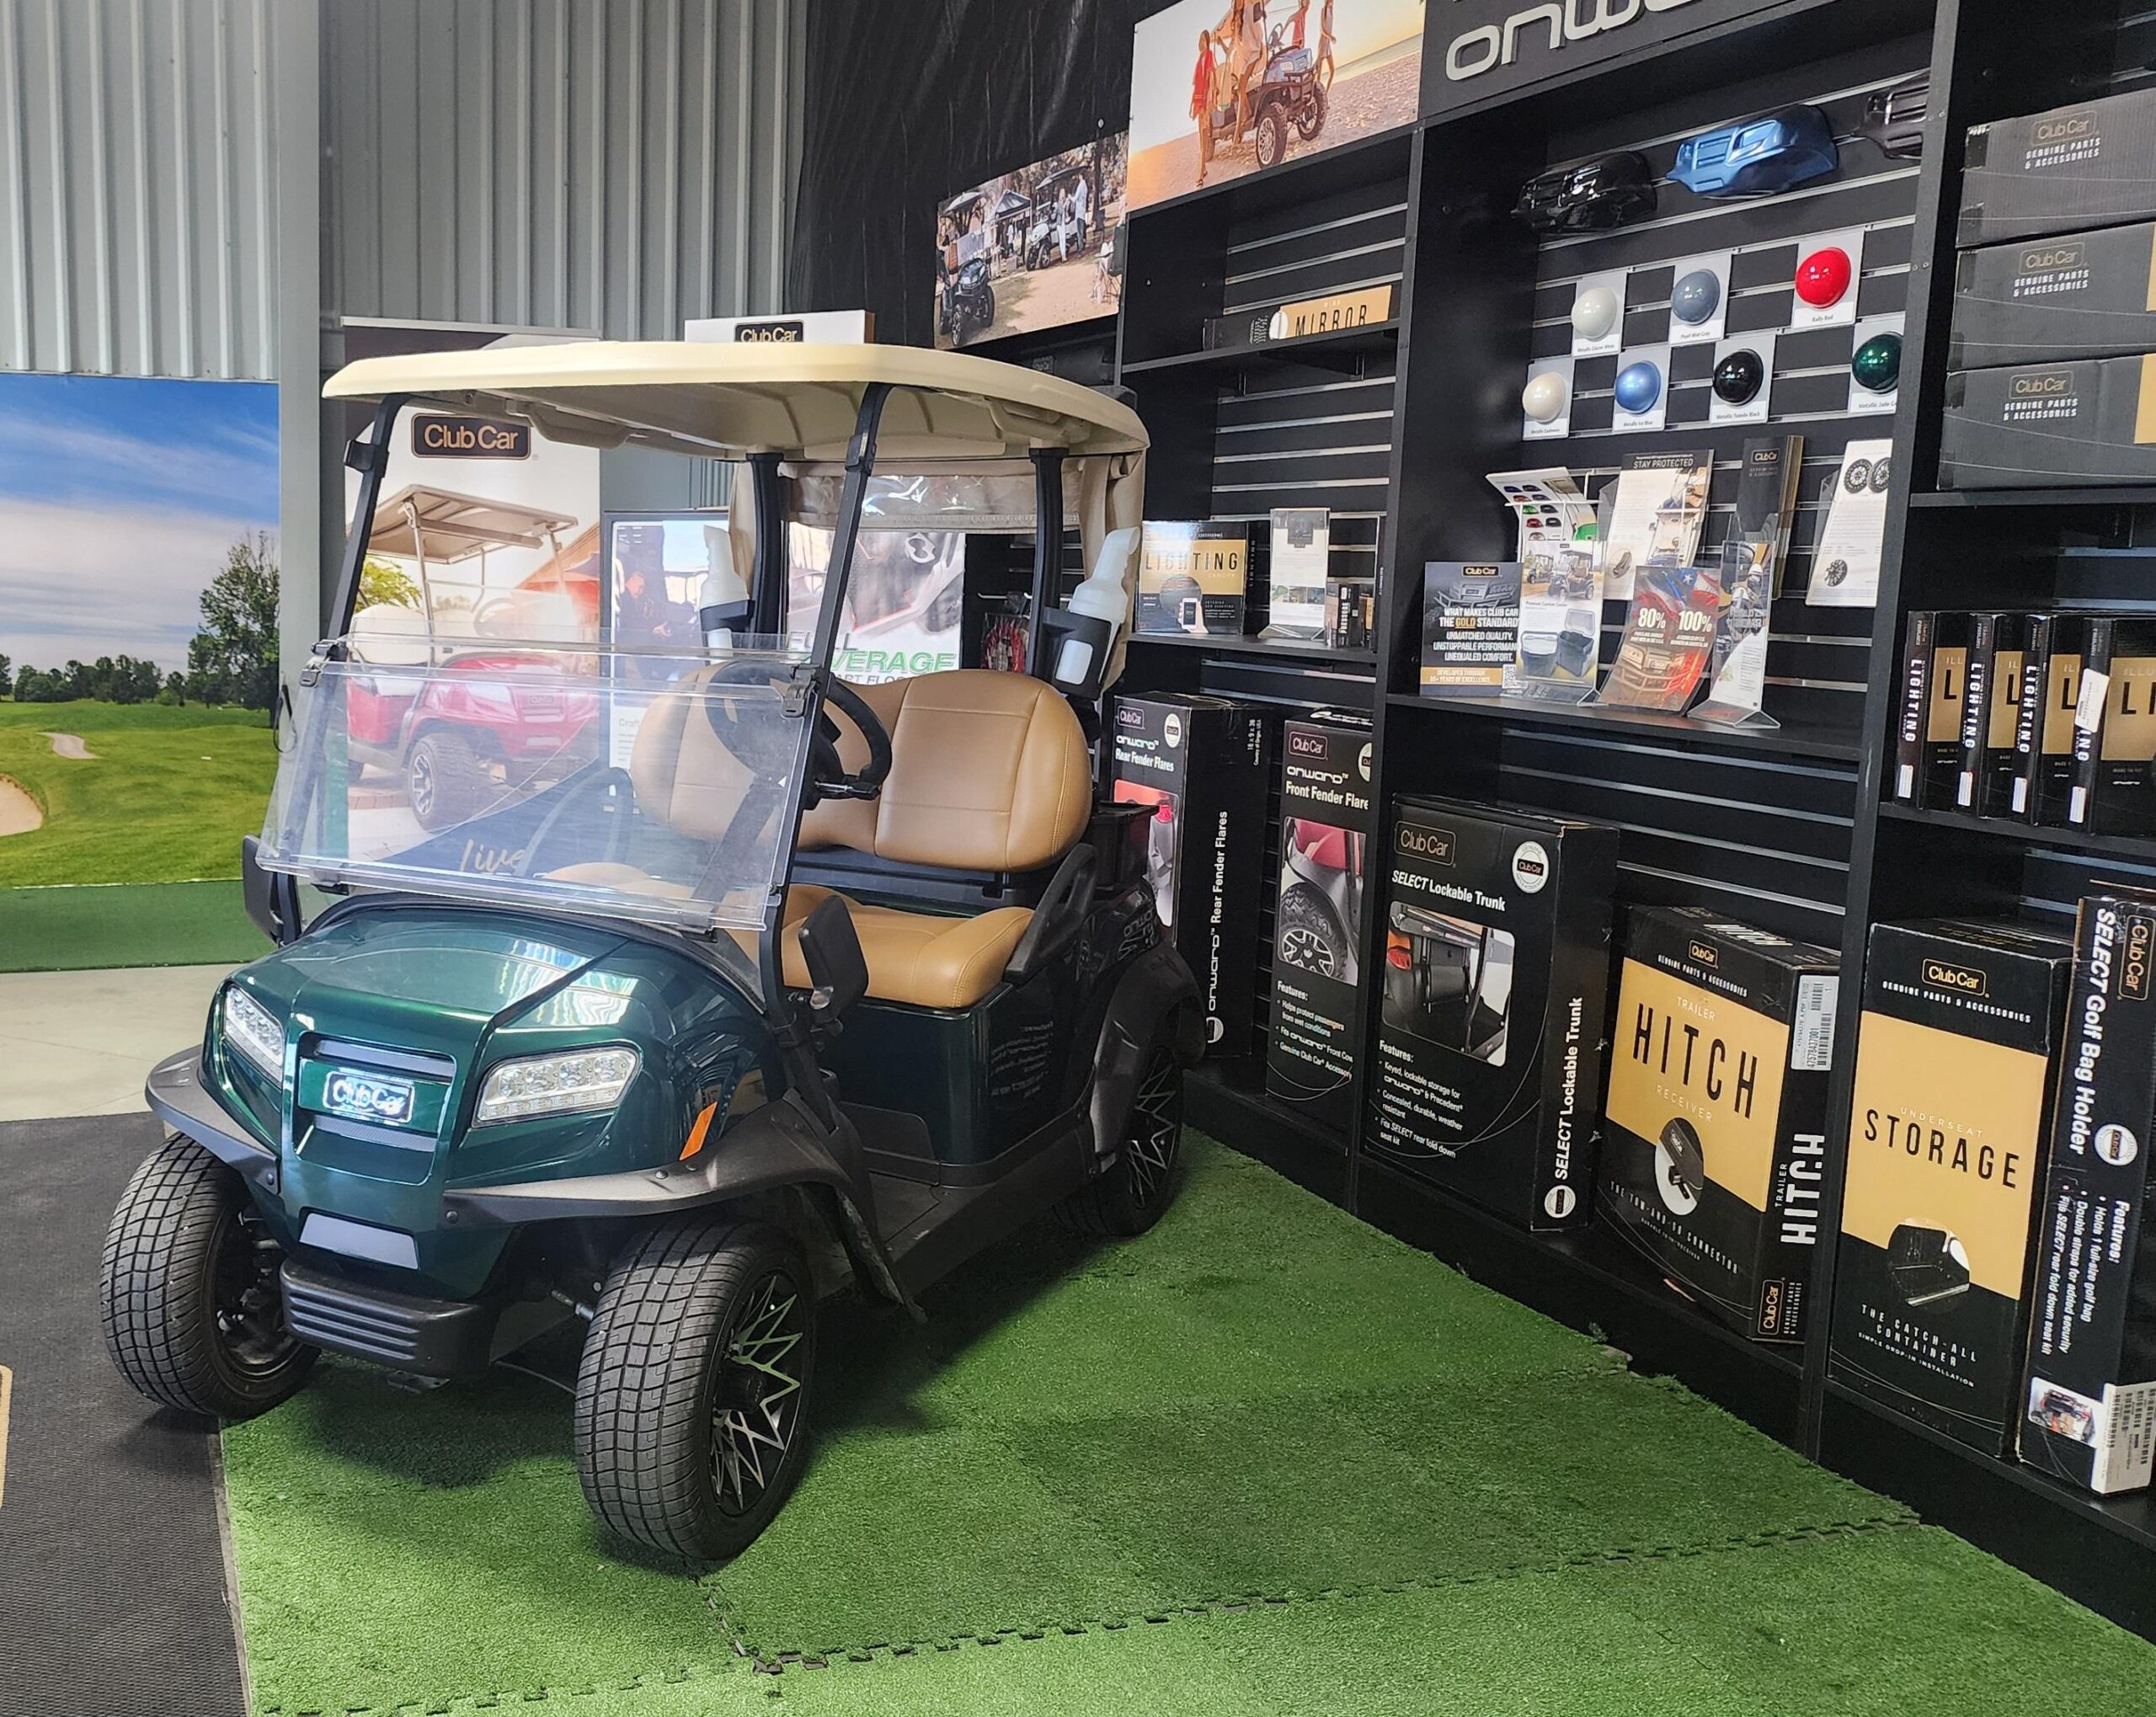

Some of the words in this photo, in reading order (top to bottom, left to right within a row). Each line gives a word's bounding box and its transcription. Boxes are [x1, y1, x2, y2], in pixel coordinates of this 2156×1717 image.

[1446, 0, 1700, 81] onw
[2025, 144, 2066, 160] GENUINE
[2070, 137, 2101, 151] PARTS
[2035, 148, 2100, 168] ACCESSORIES
[2014, 275, 2054, 288] GENUINE
[2058, 269, 2089, 281] PARTS
[2023, 280, 2089, 296] ACCESSORIES
[1294, 304, 1368, 337] MIRROR
[2004, 401, 2043, 411] GENUINE
[2047, 398, 2079, 408] PARTS
[2013, 408, 2078, 420] ACCESSORIES
[1633, 459, 1652, 470] STAY
[1652, 458, 1694, 468] PROTECTED
[1145, 552, 1238, 570] LIGHTING
[1438, 616, 1454, 627] THE
[1454, 617, 1476, 628] GOLD
[1476, 617, 1518, 627] STANDARD
[1444, 607, 1464, 616] WHAT
[1464, 607, 1487, 616] MAKES
[1487, 608, 1505, 616] CLUB
[1505, 608, 1518, 616] CAR
[1638, 608, 1666, 629] 80%
[1678, 611, 1712, 632] 100%
[1433, 642, 1477, 651] UNSTOPPABLE
[1477, 643, 1518, 651] PERFORMAN
[1446, 631, 1485, 640] UNMATCHED
[830, 651, 957, 674] VERAGE
[1444, 653, 1481, 661] UNEQUALED
[1904, 659, 1923, 742] LIGHTING
[1965, 663, 1983, 749] LIGHTING
[2019, 665, 2037, 753] LIGHTING
[1115, 748, 1130, 762] Rear
[1131, 751, 1154, 767] Fender
[1154, 757, 1174, 772] Flares
[1286, 780, 1310, 797] Front
[1311, 786, 1343, 804] Fender
[1345, 792, 1369, 810] Flare
[1215, 811, 1228, 848] Flares
[1212, 852, 1225, 898] Fender
[1392, 869, 1429, 890] SELECT
[1429, 878, 1473, 903] Lockable
[1475, 890, 1506, 911] Trunk
[1210, 898, 1222, 924] Rear
[2089, 908, 2116, 994] SELECT
[1277, 980, 1309, 1001] Features:
[1657, 954, 1681, 971] GENUINE
[1682, 962, 1700, 978] PARTS
[1708, 973, 1748, 998] ACCESSORIES
[1677, 996, 1716, 1022] TRAILER
[1882, 980, 1920, 997] GENUINE
[1923, 990, 1951, 1005] PARTS
[1966, 1000, 2032, 1024] ACCESSORIES
[2083, 994, 2106, 1041] Golf
[1305, 1021, 1331, 1037] conditions
[1315, 1015, 1345, 1031] passengers
[1566, 997, 1582, 1042] Trunk
[1380, 1039, 1414, 1063] Features:
[1632, 1003, 1758, 1119] HITCH
[2074, 1042, 2101, 1082] Bag
[1404, 1069, 1427, 1086] lockable
[1428, 1079, 1449, 1096] storage
[1450, 1088, 1460, 1100] for
[1560, 1046, 1578, 1115] Lockable
[1382, 1102, 1406, 1120] resistant
[1656, 1085, 1713, 1122] RECEIVER
[1438, 1114, 1463, 1131] weather
[1900, 1106, 1983, 1137] UNDERSEAT
[2068, 1086, 2096, 1155] Holder
[1380, 1118, 1390, 1130] Fits
[1390, 1122, 1413, 1138] SELECT
[1413, 1133, 1425, 1144] rear
[1426, 1138, 1438, 1151] fold
[1438, 1144, 1456, 1160] down
[1555, 1118, 1572, 1180] SELECT
[1865, 1109, 2020, 1189] STORAGE
[1774, 1164, 1788, 1208] TRAILER
[1780, 1133, 1825, 1245] HITCH
[1609, 1181, 1625, 1197] THE
[1687, 1231, 1739, 1274] CONNECTOR
[2052, 1213, 2068, 1251] SELECT
[2073, 1201, 2089, 1235] Double
[2092, 1205, 2107, 1234] Holds
[2107, 1200, 2130, 1263] Features:
[2047, 1272, 2062, 1292] fold
[2068, 1267, 2082, 1282] for
[2044, 1293, 2057, 1320] down
[2063, 1282, 2079, 1314] added
[2081, 1282, 2097, 1304] golf
[2079, 1304, 2095, 1323] bag
[1861, 1304, 1885, 1323] THE
[1895, 1318, 1977, 1362] CATCH-ALL
[1876, 1325, 1956, 1368] CONTAINER
[1858, 1331, 1883, 1347] SIMPLE
[1885, 1344, 1917, 1362] DROP-IN
[1919, 1360, 1975, 1388] INSTALLATION
[2041, 1341, 2053, 1357] kit
